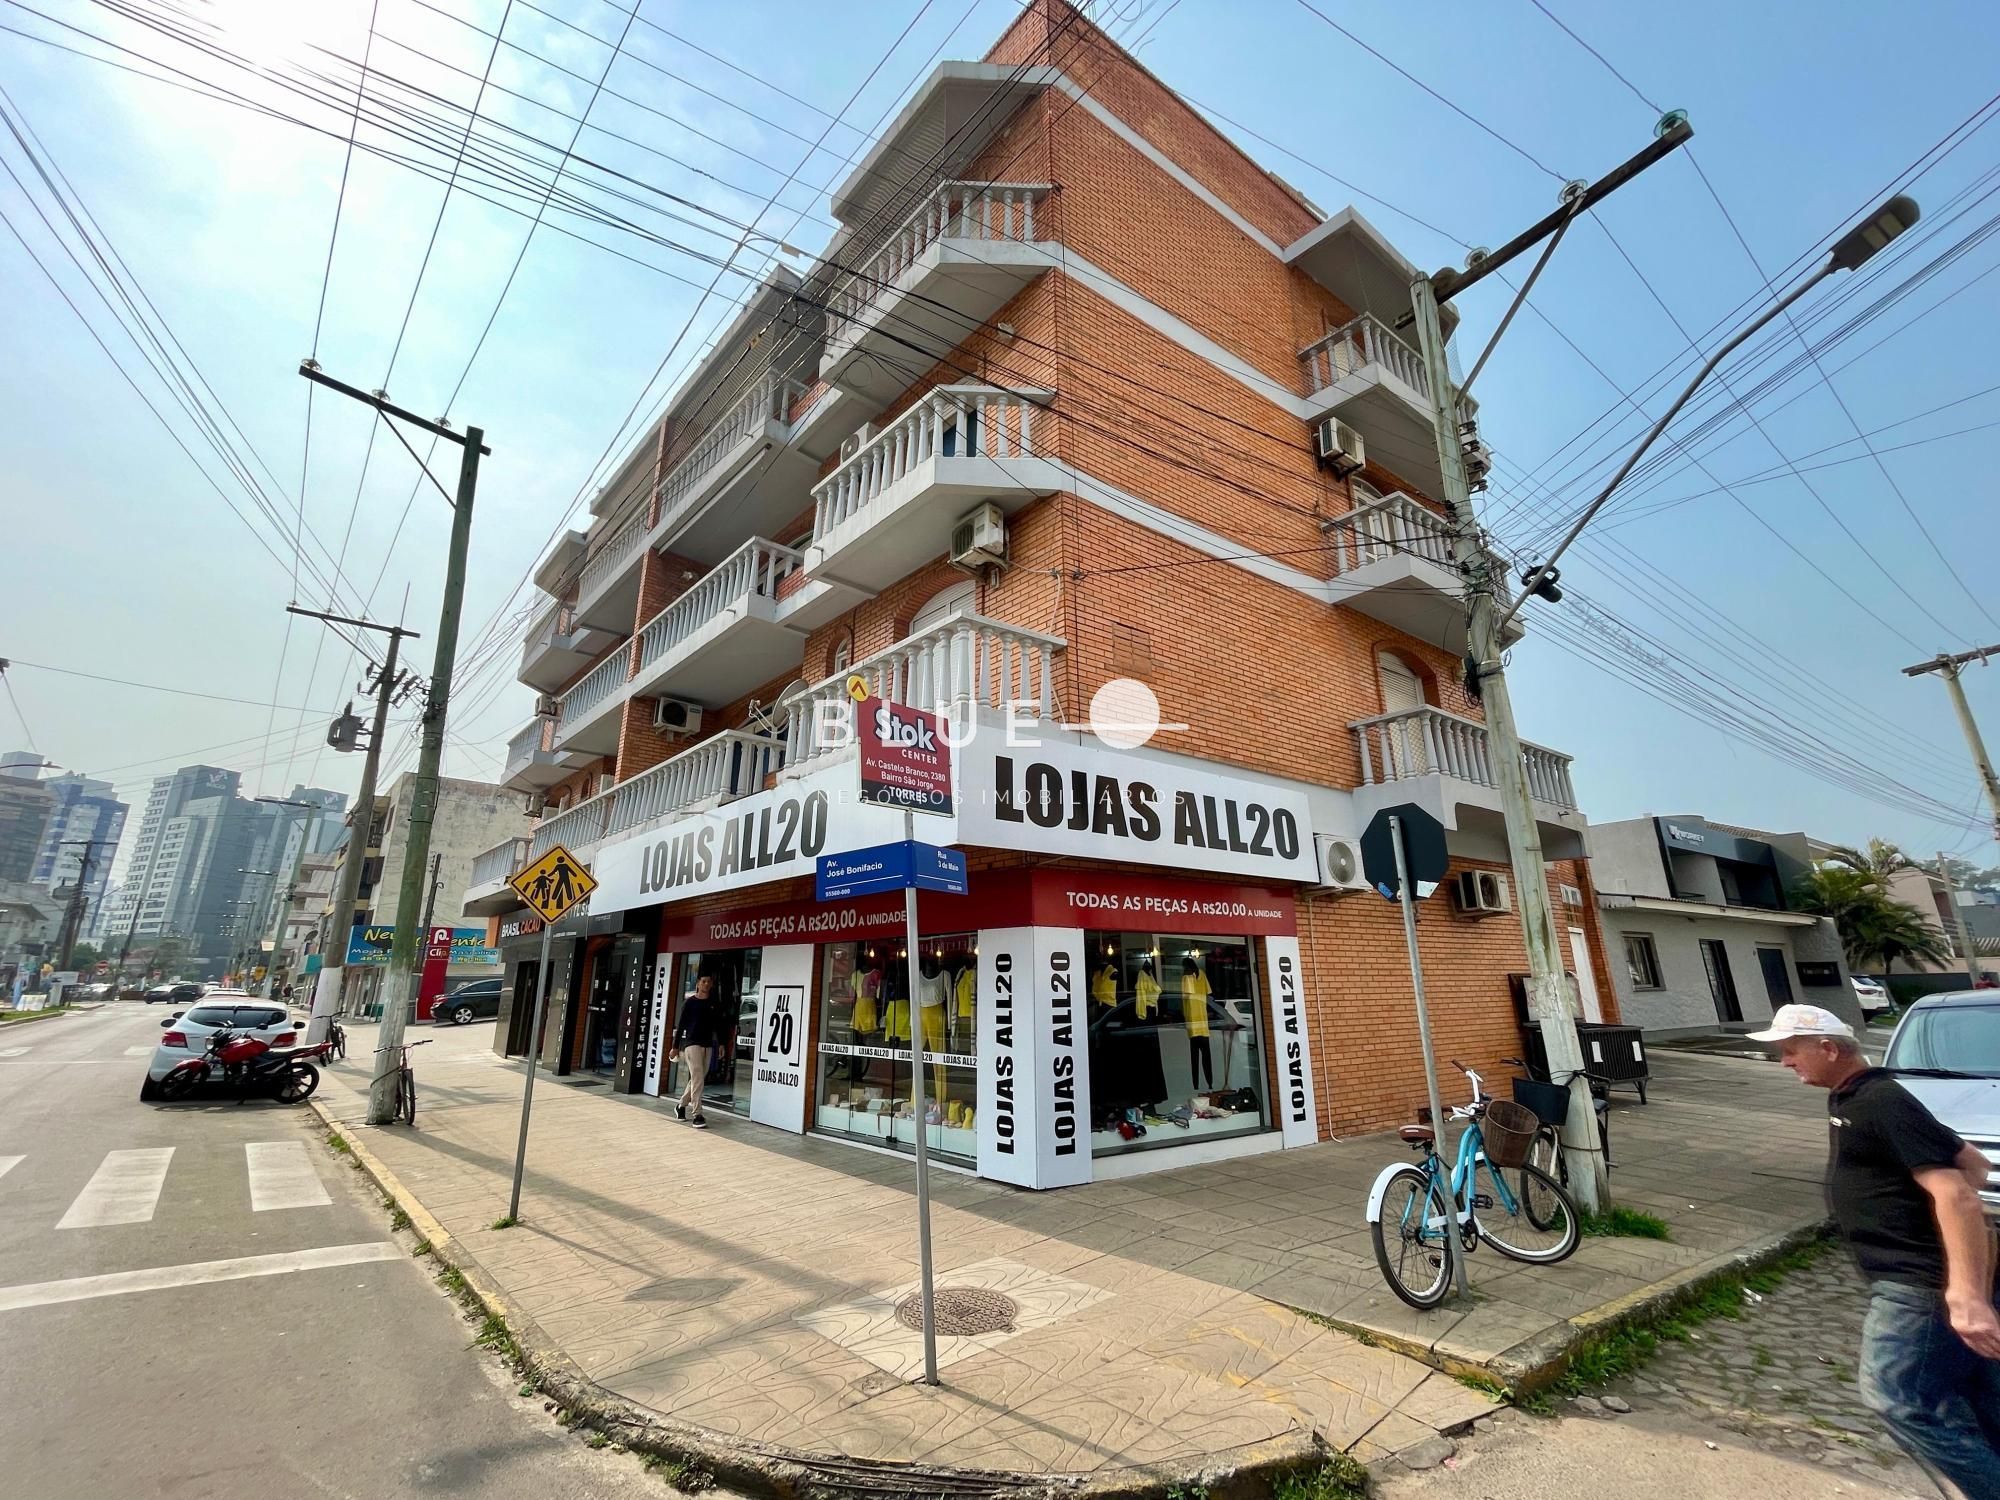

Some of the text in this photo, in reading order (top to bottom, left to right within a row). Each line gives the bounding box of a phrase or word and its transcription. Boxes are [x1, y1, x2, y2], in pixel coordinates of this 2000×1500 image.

[875, 708, 936, 752] Stok
[901, 749, 938, 765] CENTER
[866, 757, 946, 783] Av. Castelo Branco, 2380
[881, 771, 934, 791] Bairro São Jorge
[889, 786, 928, 803] TORRES
[995, 756, 1300, 860] LOJAS ALL20
[639, 789, 828, 895] LOJAS ALL20
[826, 860, 838, 869] Av.
[937, 851, 947, 860] Rua
[826, 862, 883, 878] José Bonifacio
[938, 860, 942, 868] 3
[948, 863, 959, 872] Maio
[1066, 891, 1283, 919] TODAS AS PEÇAS A R$20,00 A UNIDADE
[501, 918, 540, 938] BRASIL CACAU
[710, 908, 908, 940] TODAS AS PEÇAS A R$20,00 A UNIDADE
[775, 995, 790, 1012] ALL
[635, 965, 652, 1068] TTL SISTEMAS
[768, 1013, 793, 1055] 20
[1279, 957, 1307, 1122] LOJAS ALL20
[821, 1044, 848, 1054] LOJAS ALL20
[859, 1047, 889, 1058] LOJAS ALL20
[995, 953, 1014, 1154] LOJAS ALL20
[1050, 951, 1076, 1156] LOJAS ALL20
[943, 1055, 978, 1066] LOJAS ALL2
[758, 1068, 799, 1087] LOJAS ALL20
